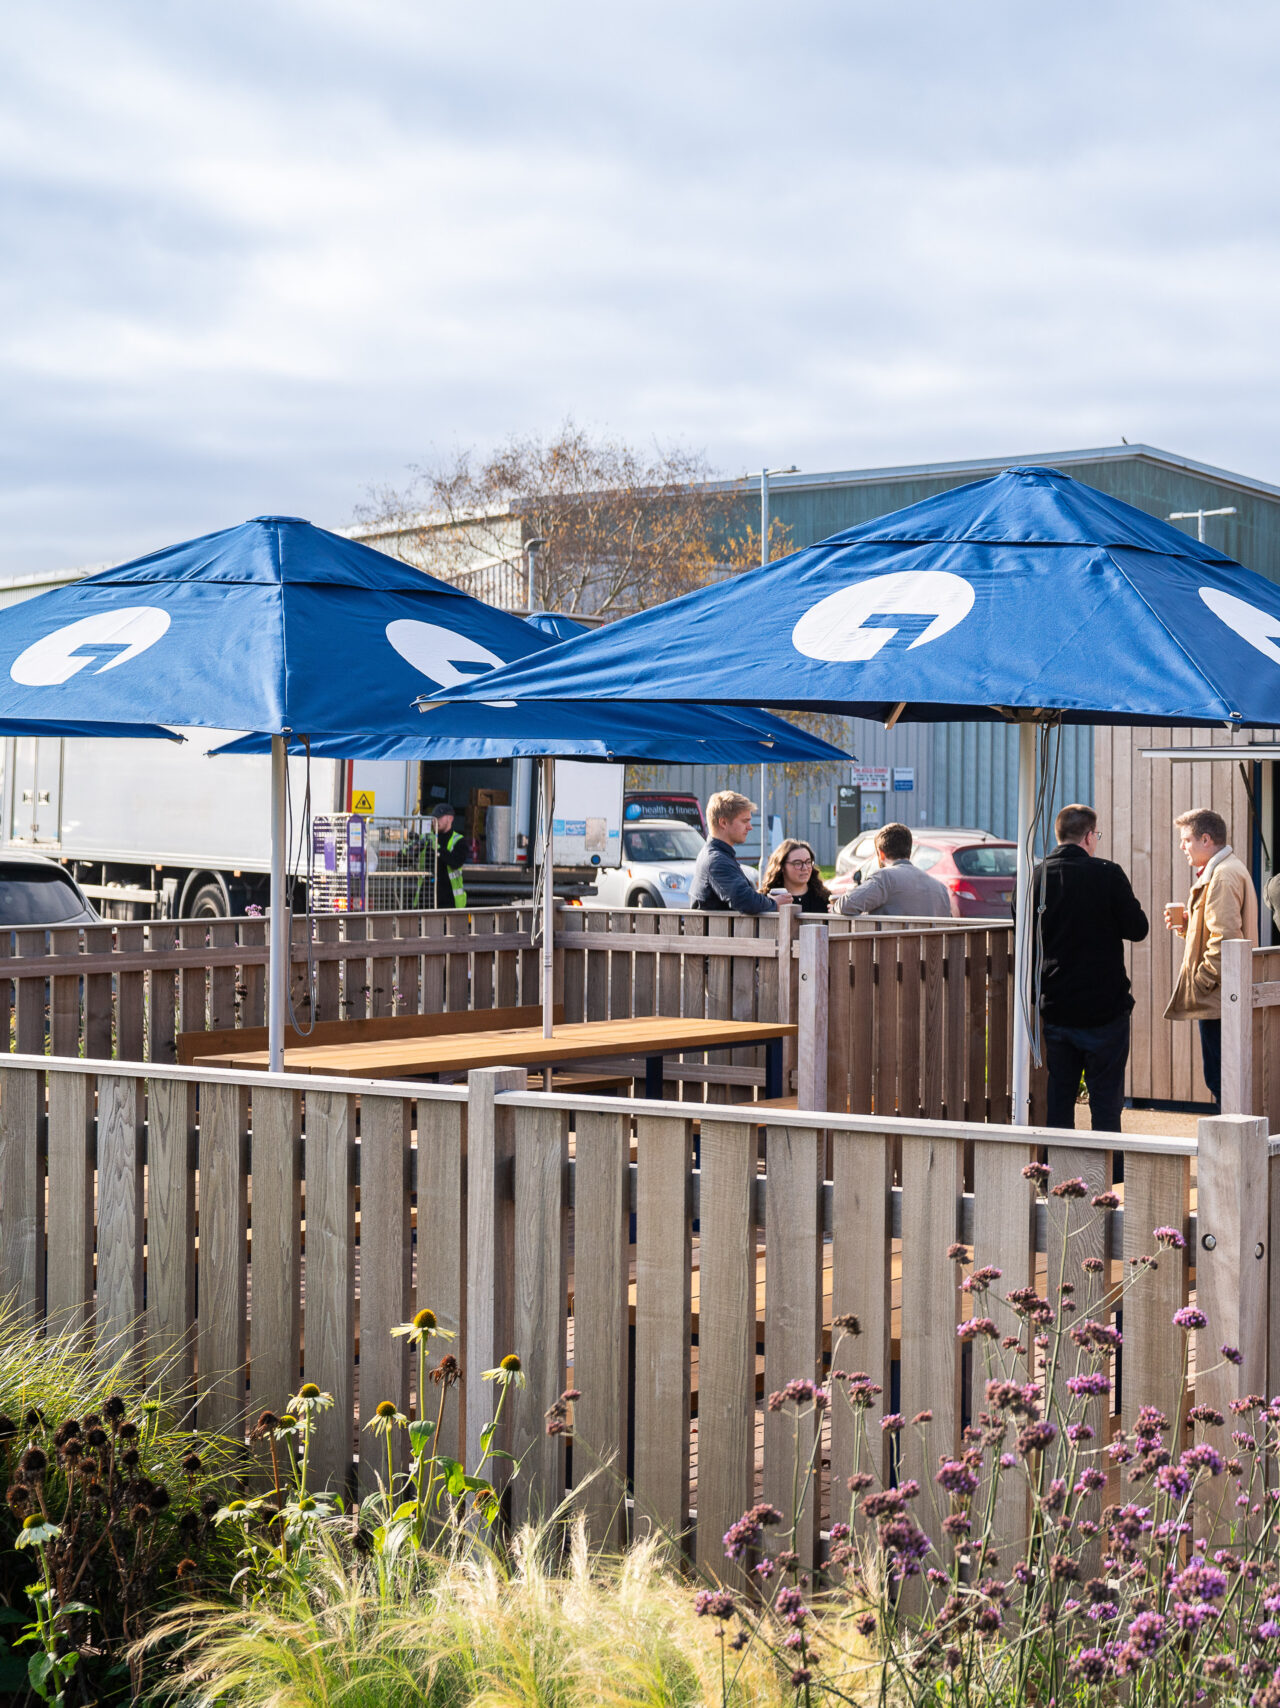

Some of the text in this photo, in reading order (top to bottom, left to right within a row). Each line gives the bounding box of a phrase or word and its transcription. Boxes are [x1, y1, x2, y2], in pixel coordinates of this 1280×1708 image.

[642, 804, 699, 815] health & fitness
